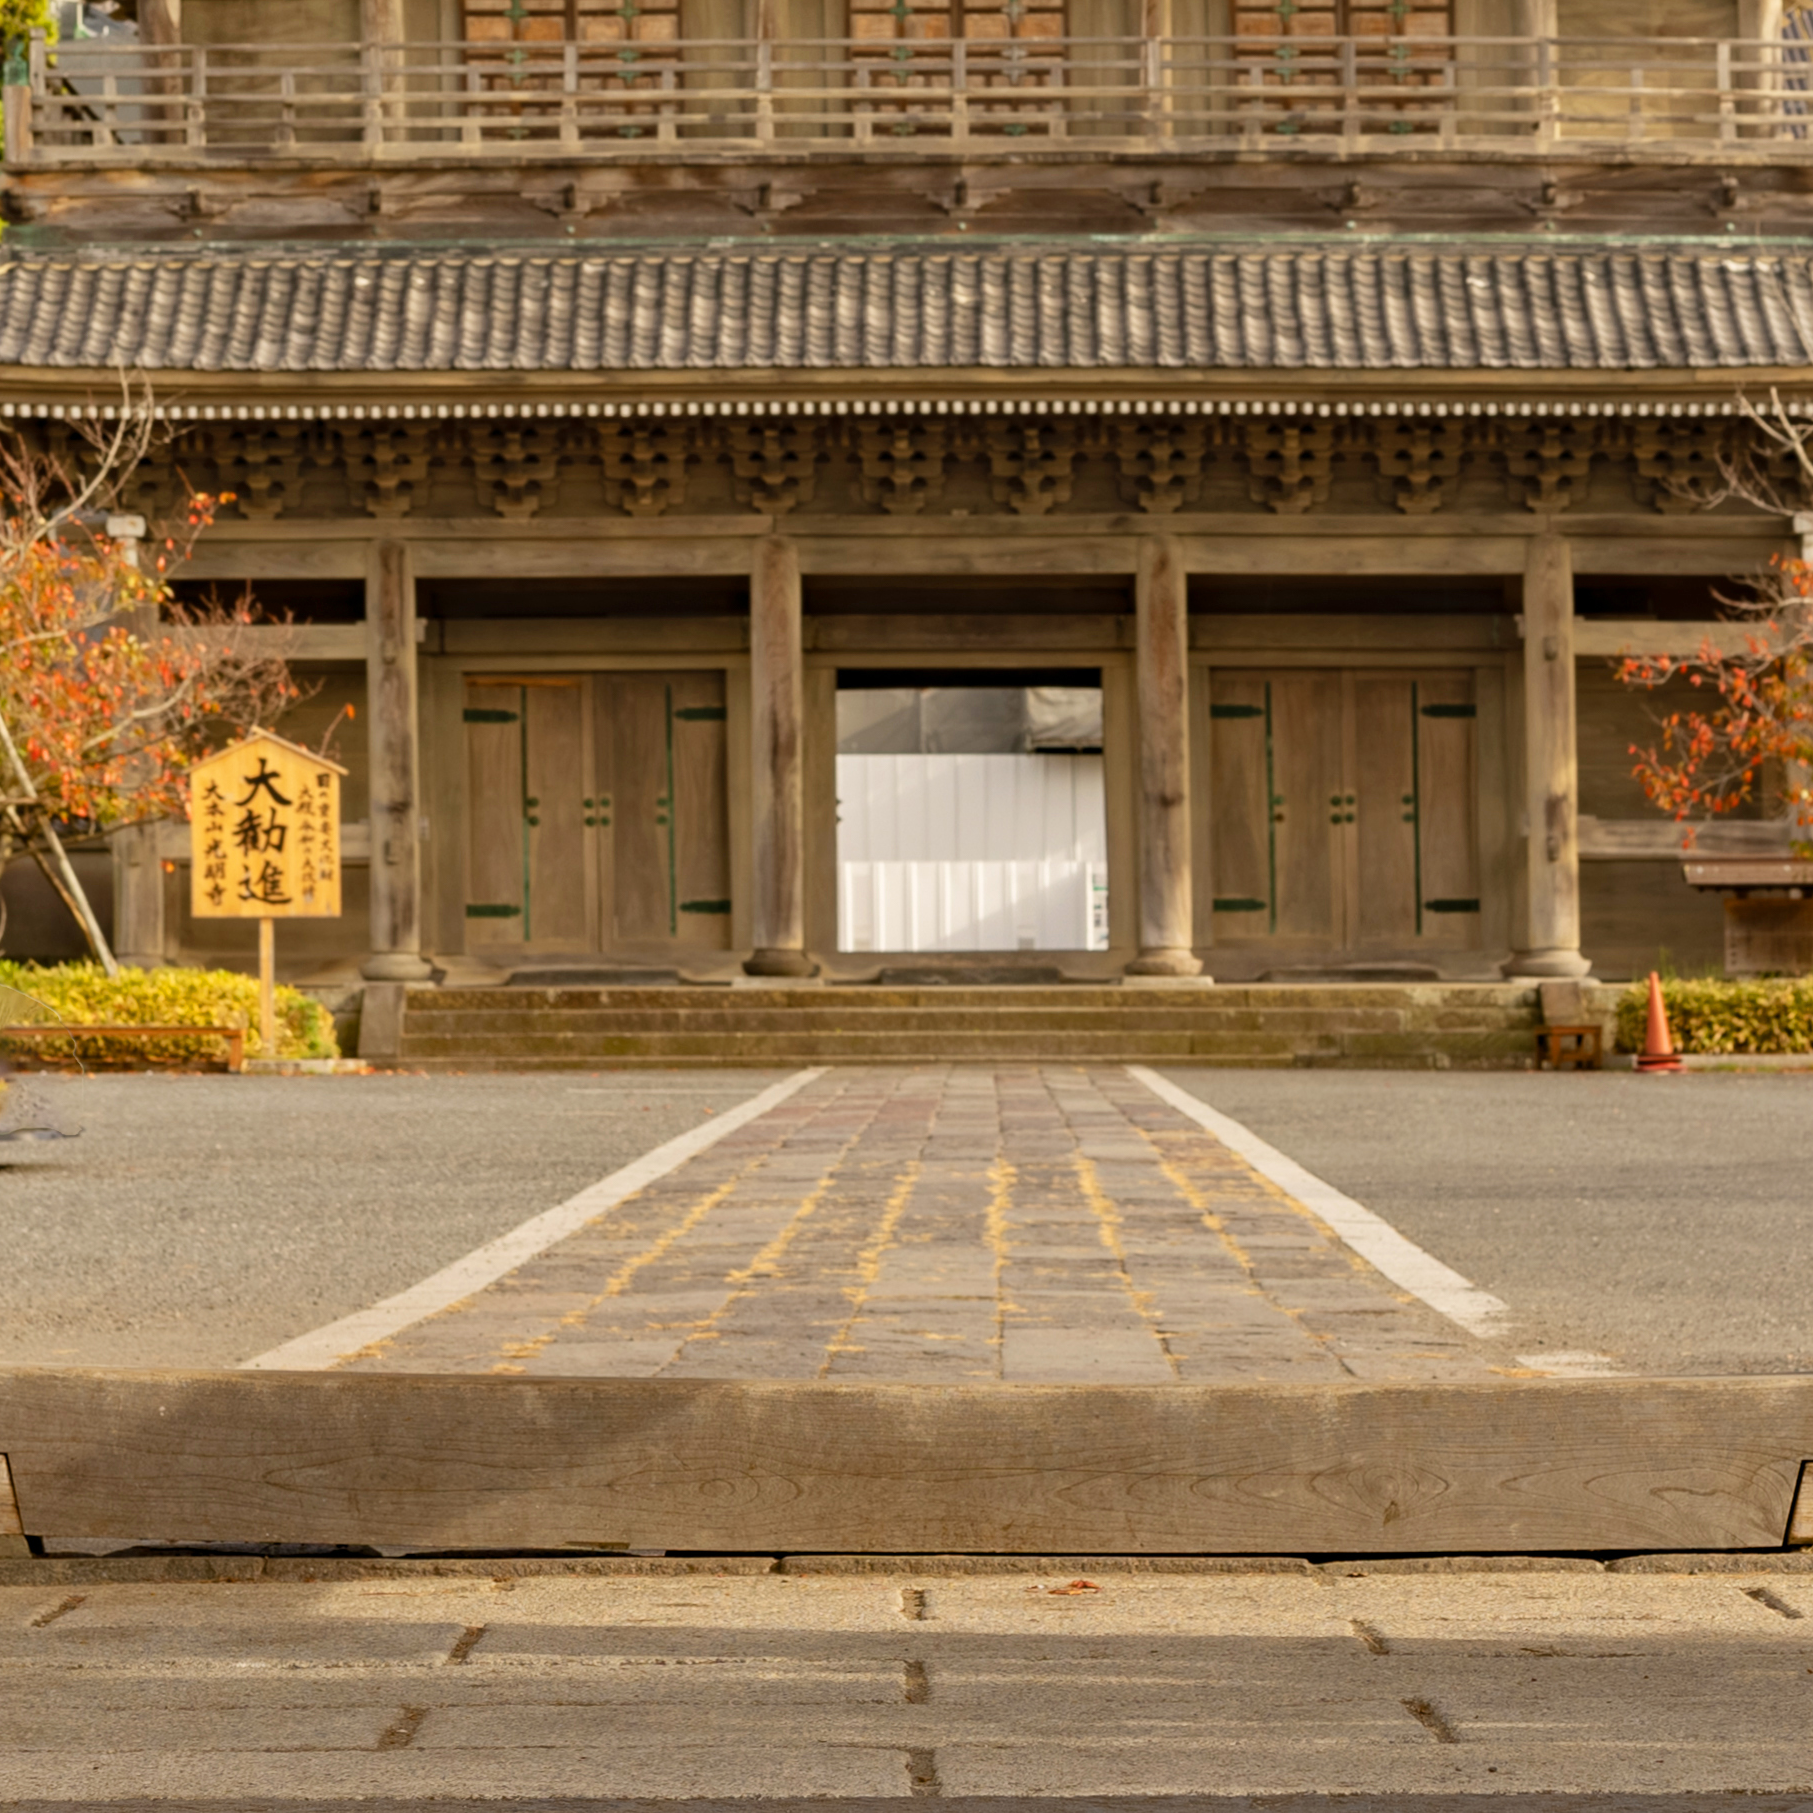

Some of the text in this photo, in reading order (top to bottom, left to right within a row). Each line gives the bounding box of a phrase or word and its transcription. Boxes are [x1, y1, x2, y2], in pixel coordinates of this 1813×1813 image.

[201, 779, 227, 907] 大本山光明寺
[232, 757, 293, 905] 大勧進
